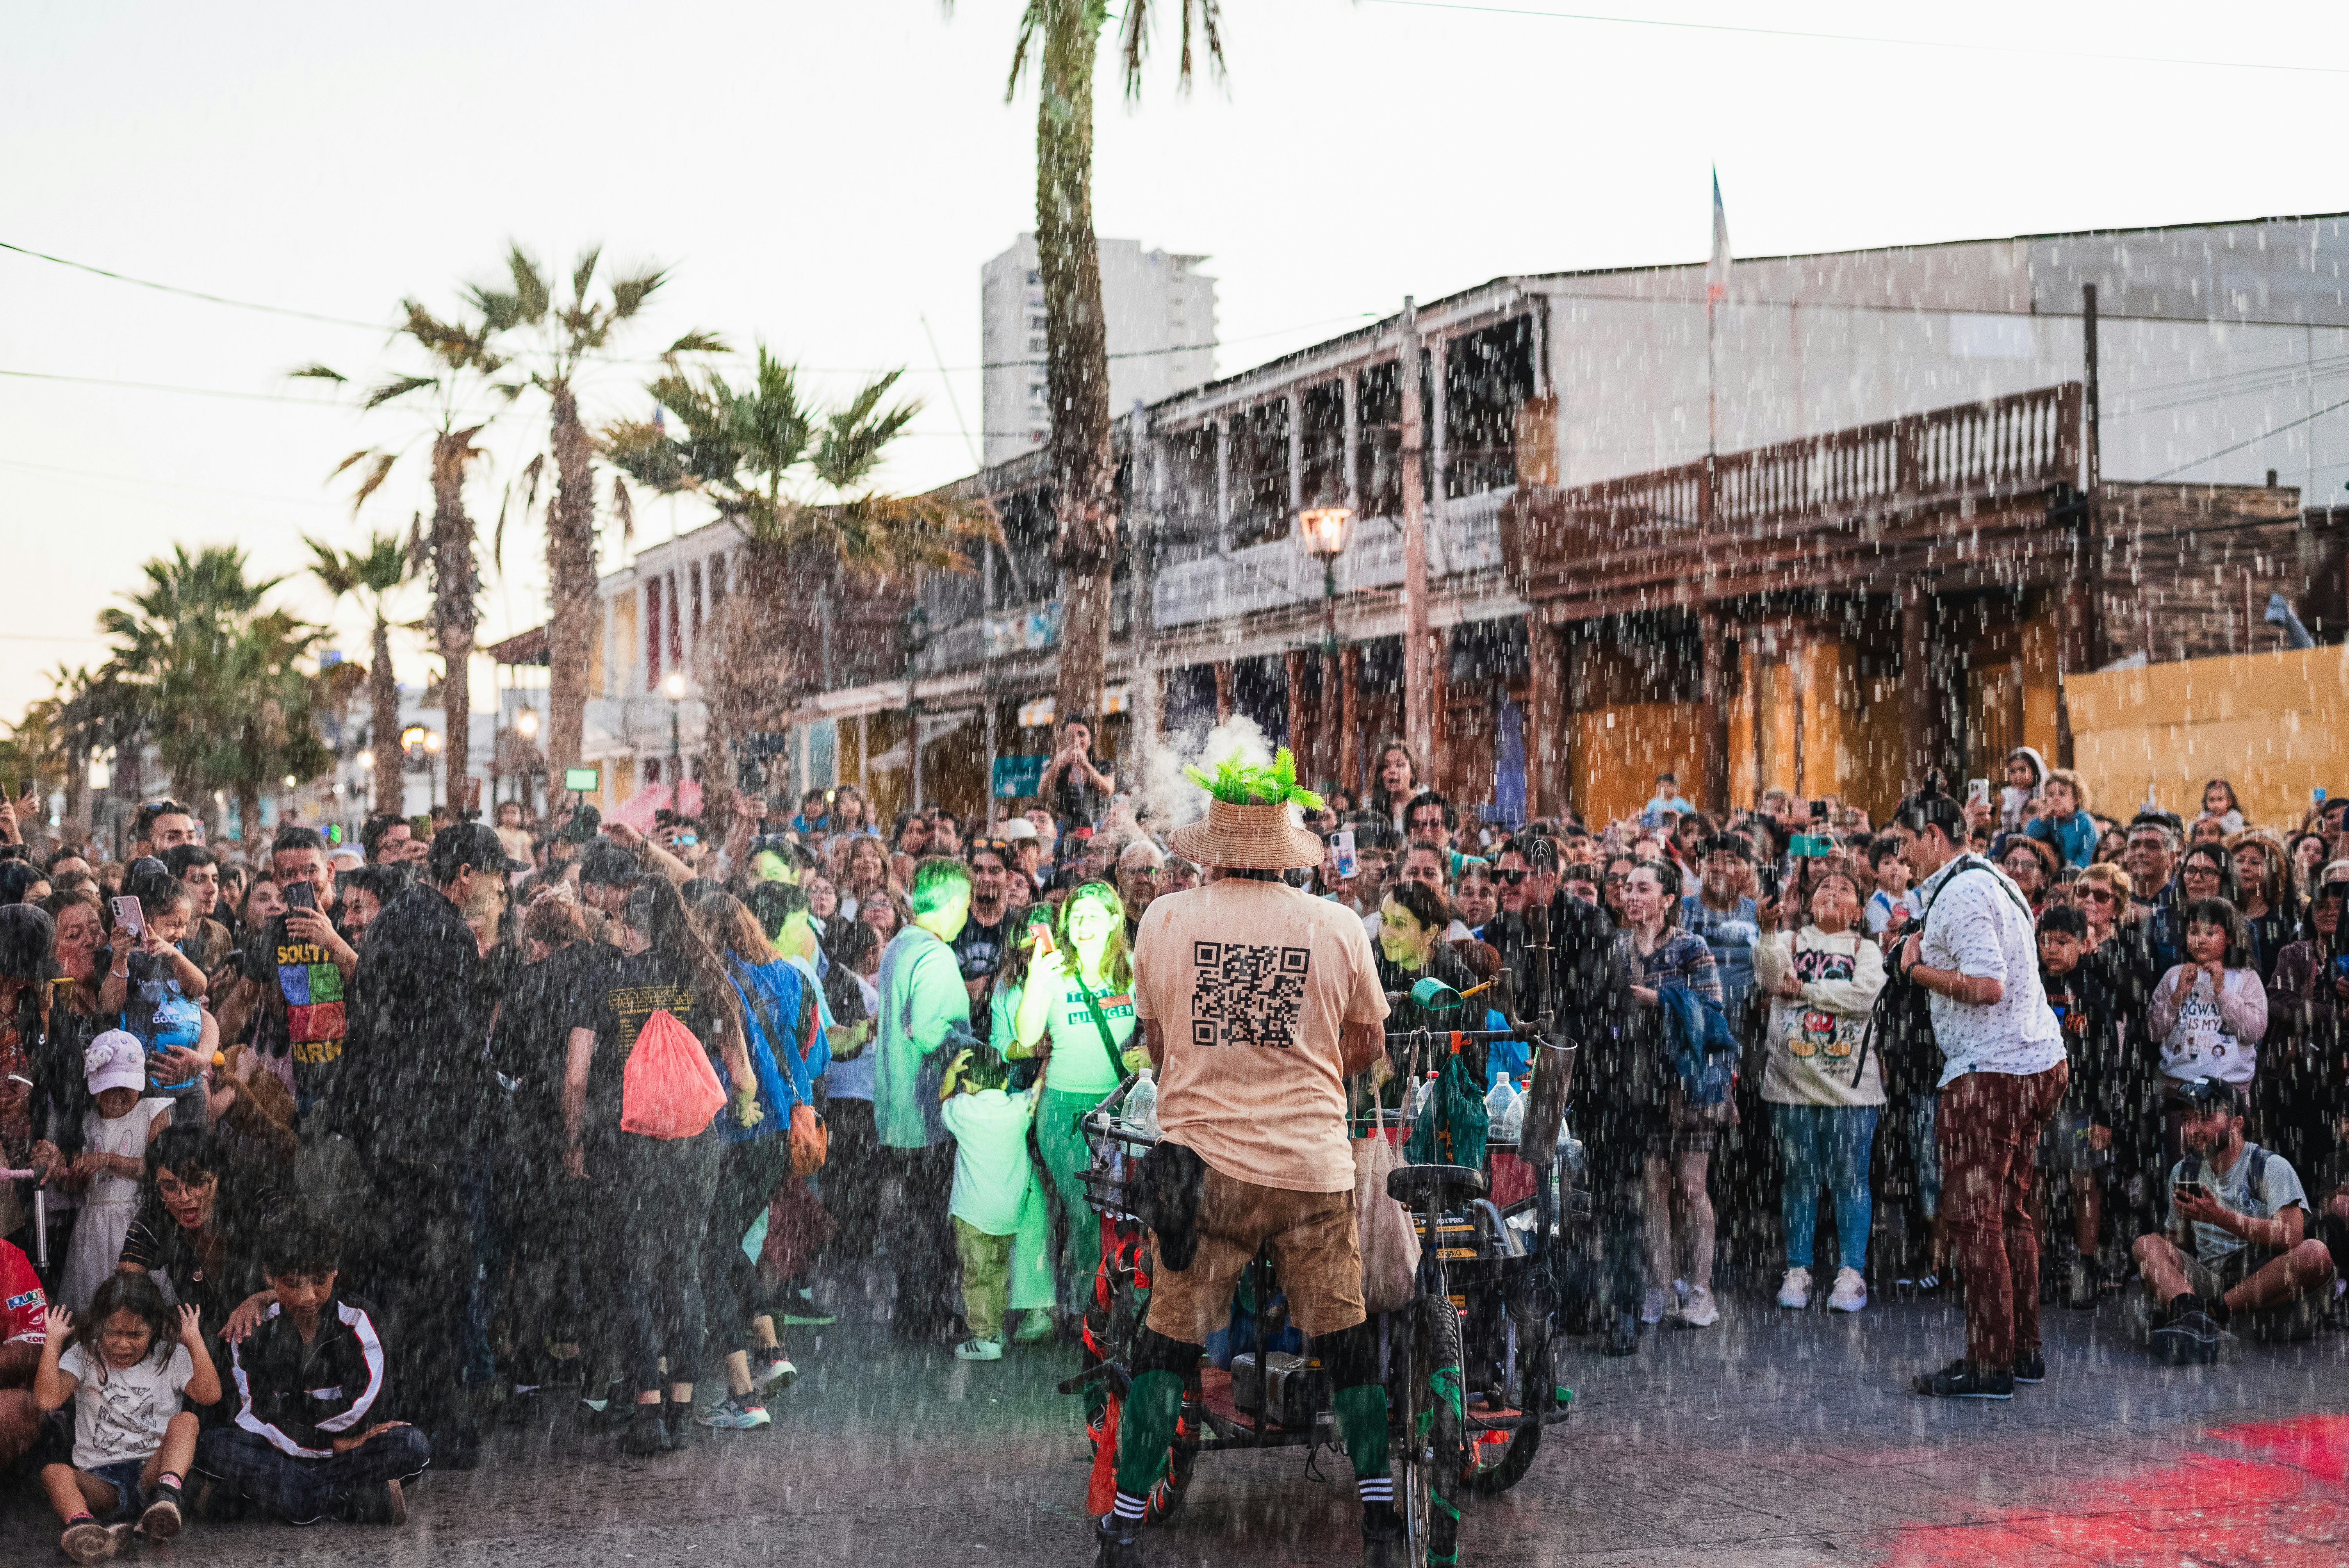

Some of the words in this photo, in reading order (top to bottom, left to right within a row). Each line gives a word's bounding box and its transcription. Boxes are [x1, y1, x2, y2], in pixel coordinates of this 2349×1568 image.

[2181, 1002, 2221, 1018] OGWA
[2188, 1017, 2199, 1030] IS
[2201, 1018, 2219, 1031] MY
